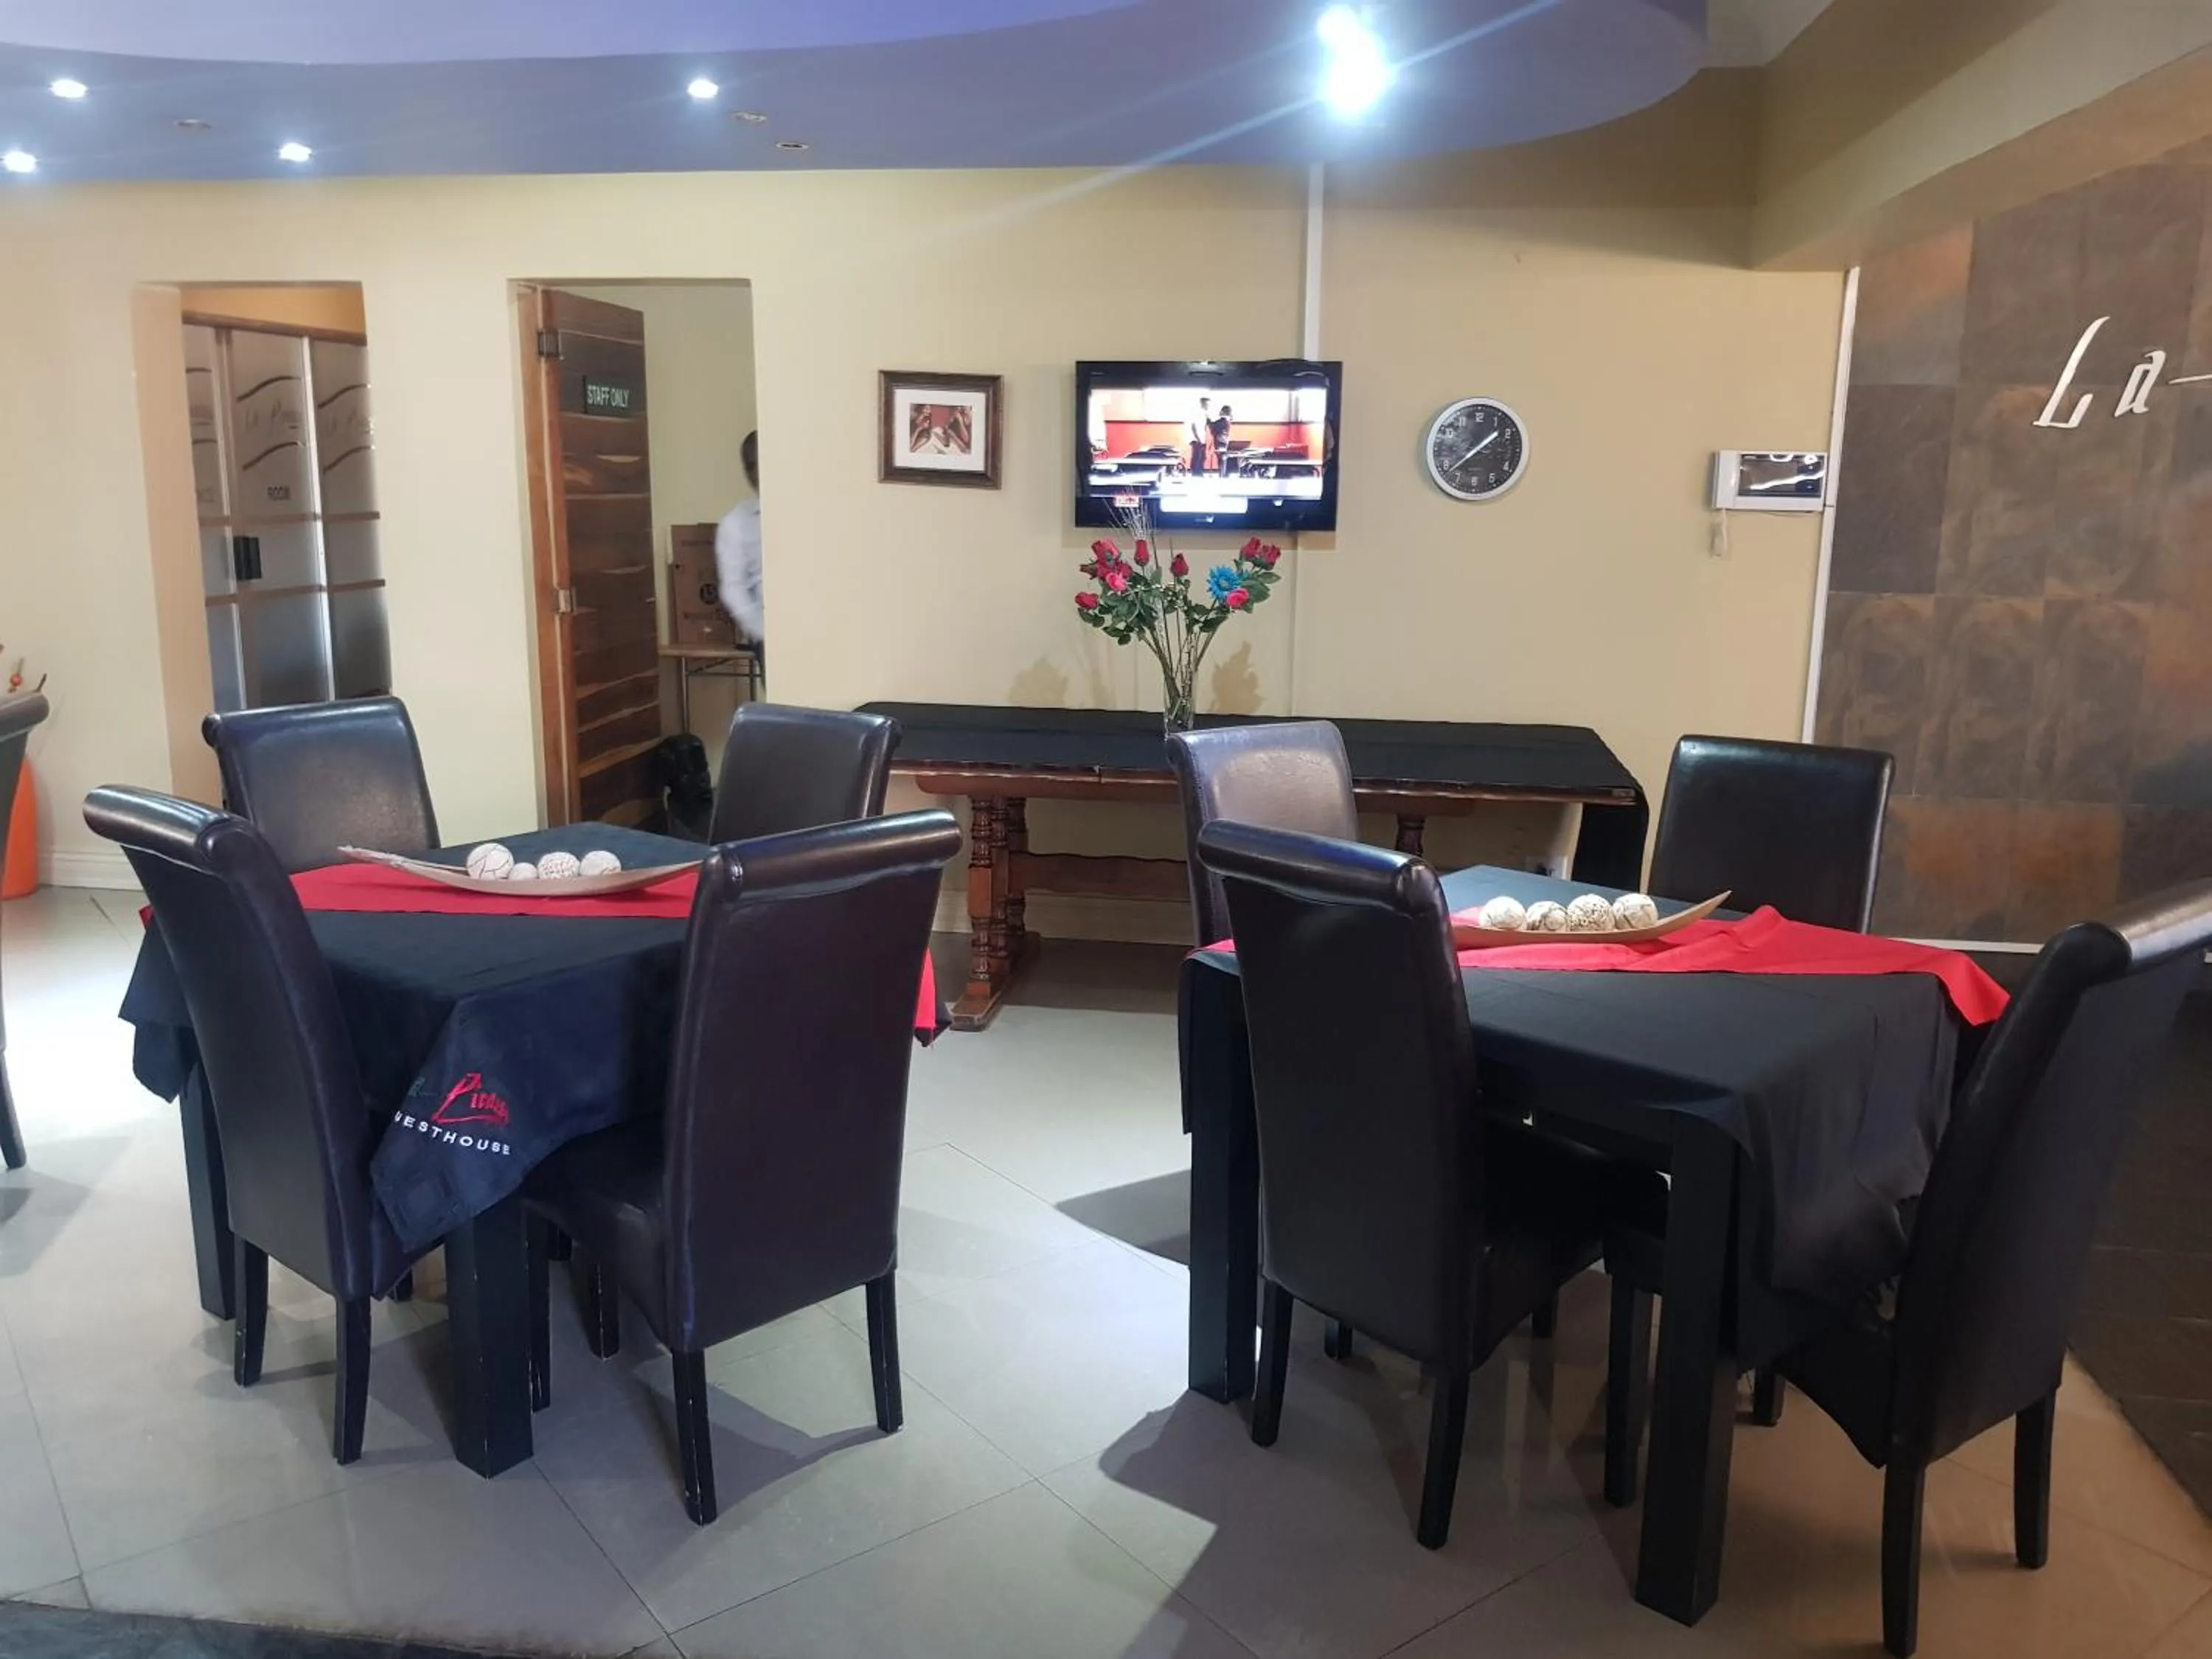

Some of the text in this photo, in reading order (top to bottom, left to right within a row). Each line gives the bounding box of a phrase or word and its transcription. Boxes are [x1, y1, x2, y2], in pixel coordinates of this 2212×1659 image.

[2032, 316, 2166, 429] La
[587, 384, 630, 408] STAFF ONLY
[1475, 412, 1484, 422] 12
